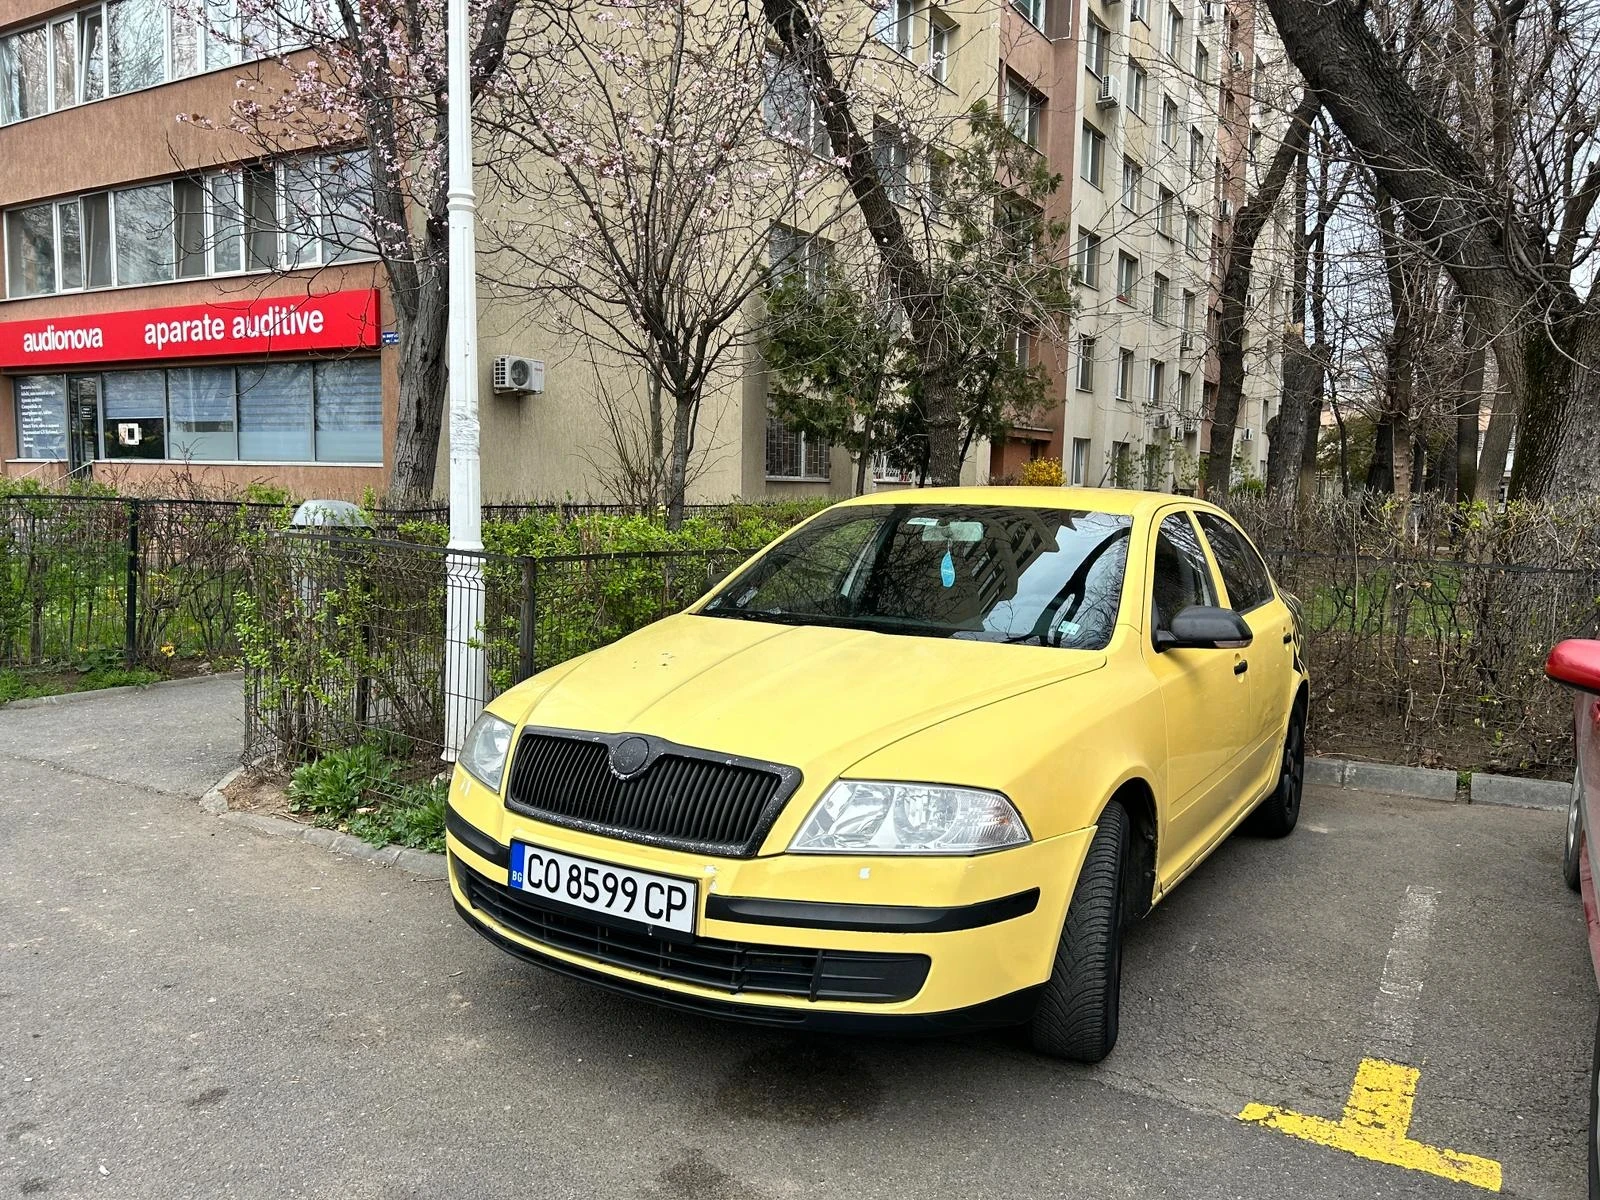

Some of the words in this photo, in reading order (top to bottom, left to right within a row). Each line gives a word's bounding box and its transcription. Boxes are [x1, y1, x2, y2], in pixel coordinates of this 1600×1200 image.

[23, 324, 103, 352] audionova
[144, 313, 225, 350] aparate
[232, 304, 324, 339] auditive
[511, 870, 523, 883] BG
[527, 853, 561, 893] CO
[566, 863, 638, 913] 8599
[644, 881, 687, 923] CP
